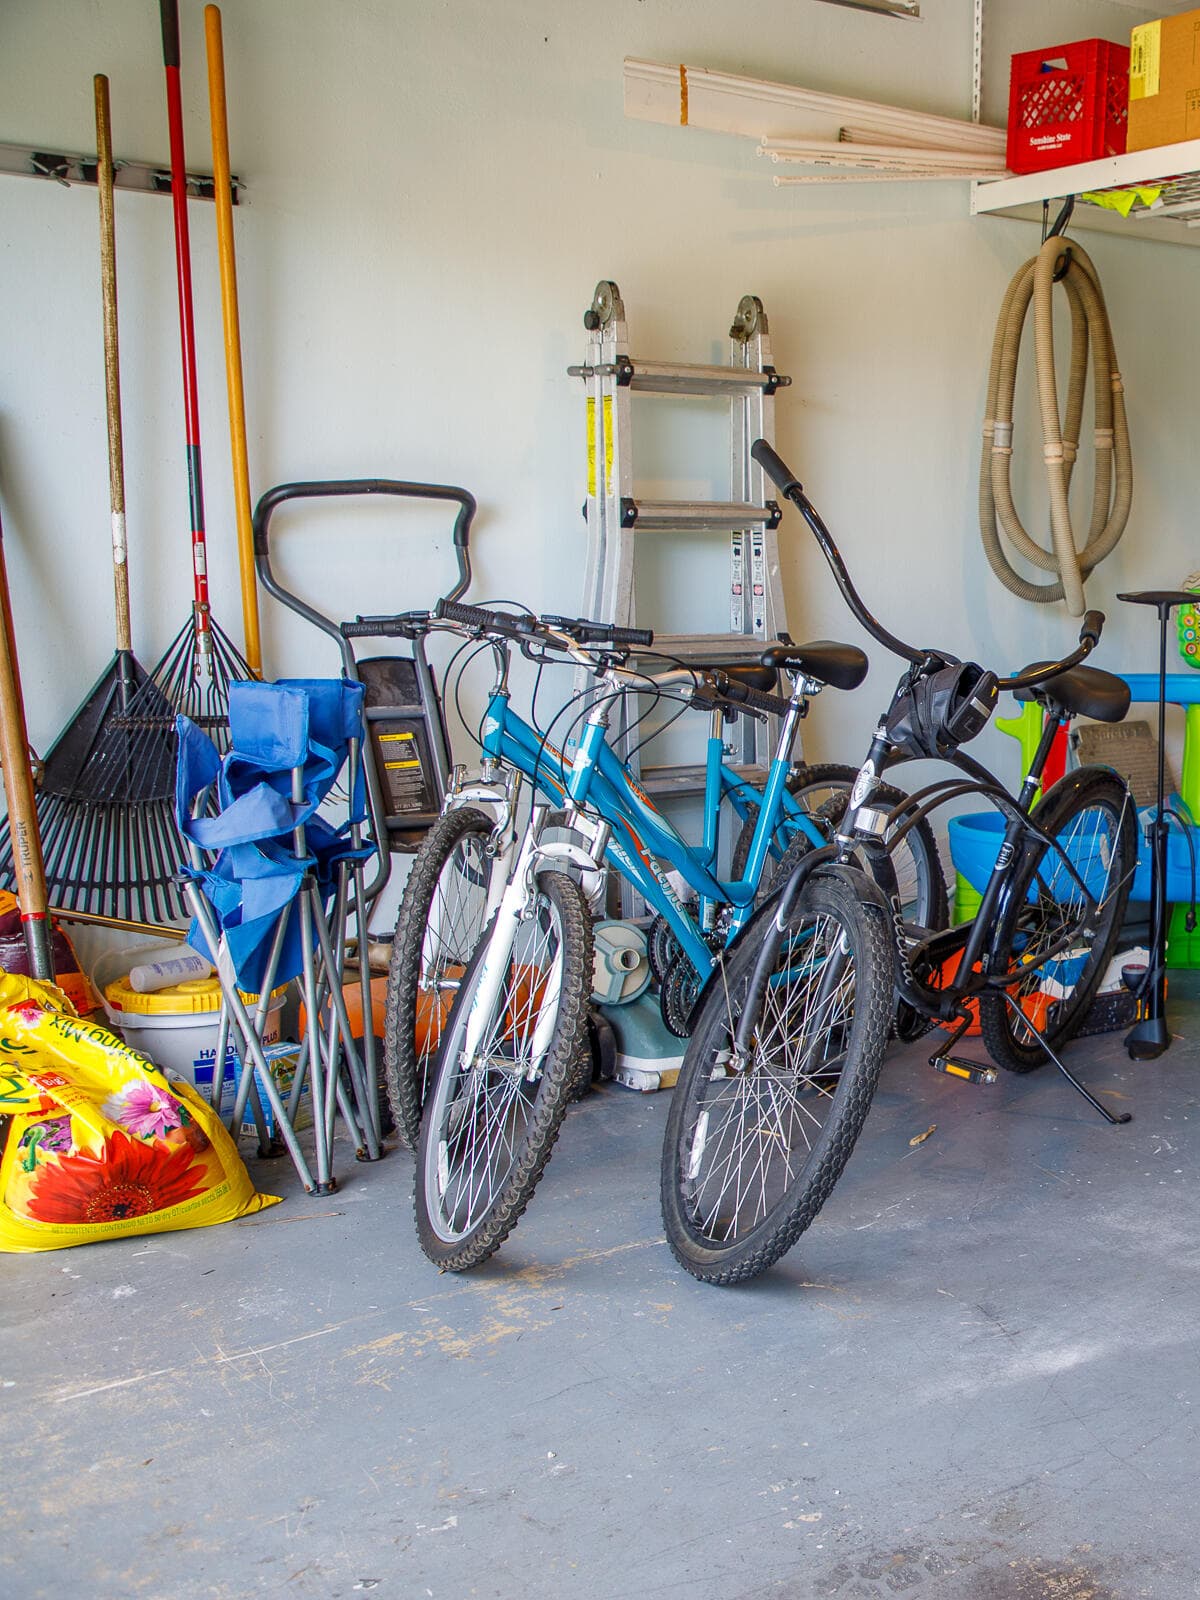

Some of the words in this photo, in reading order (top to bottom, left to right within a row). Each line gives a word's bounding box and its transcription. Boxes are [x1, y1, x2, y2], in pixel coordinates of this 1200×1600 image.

[1029, 135, 1056, 146] Sunshine
[1056, 133, 1072, 142] State
[16, 820, 32, 867] TRUPER
[640, 847, 685, 913] Pacific
[49, 1014, 86, 1044] Mix
[262, 1030, 278, 1045] PLUS
